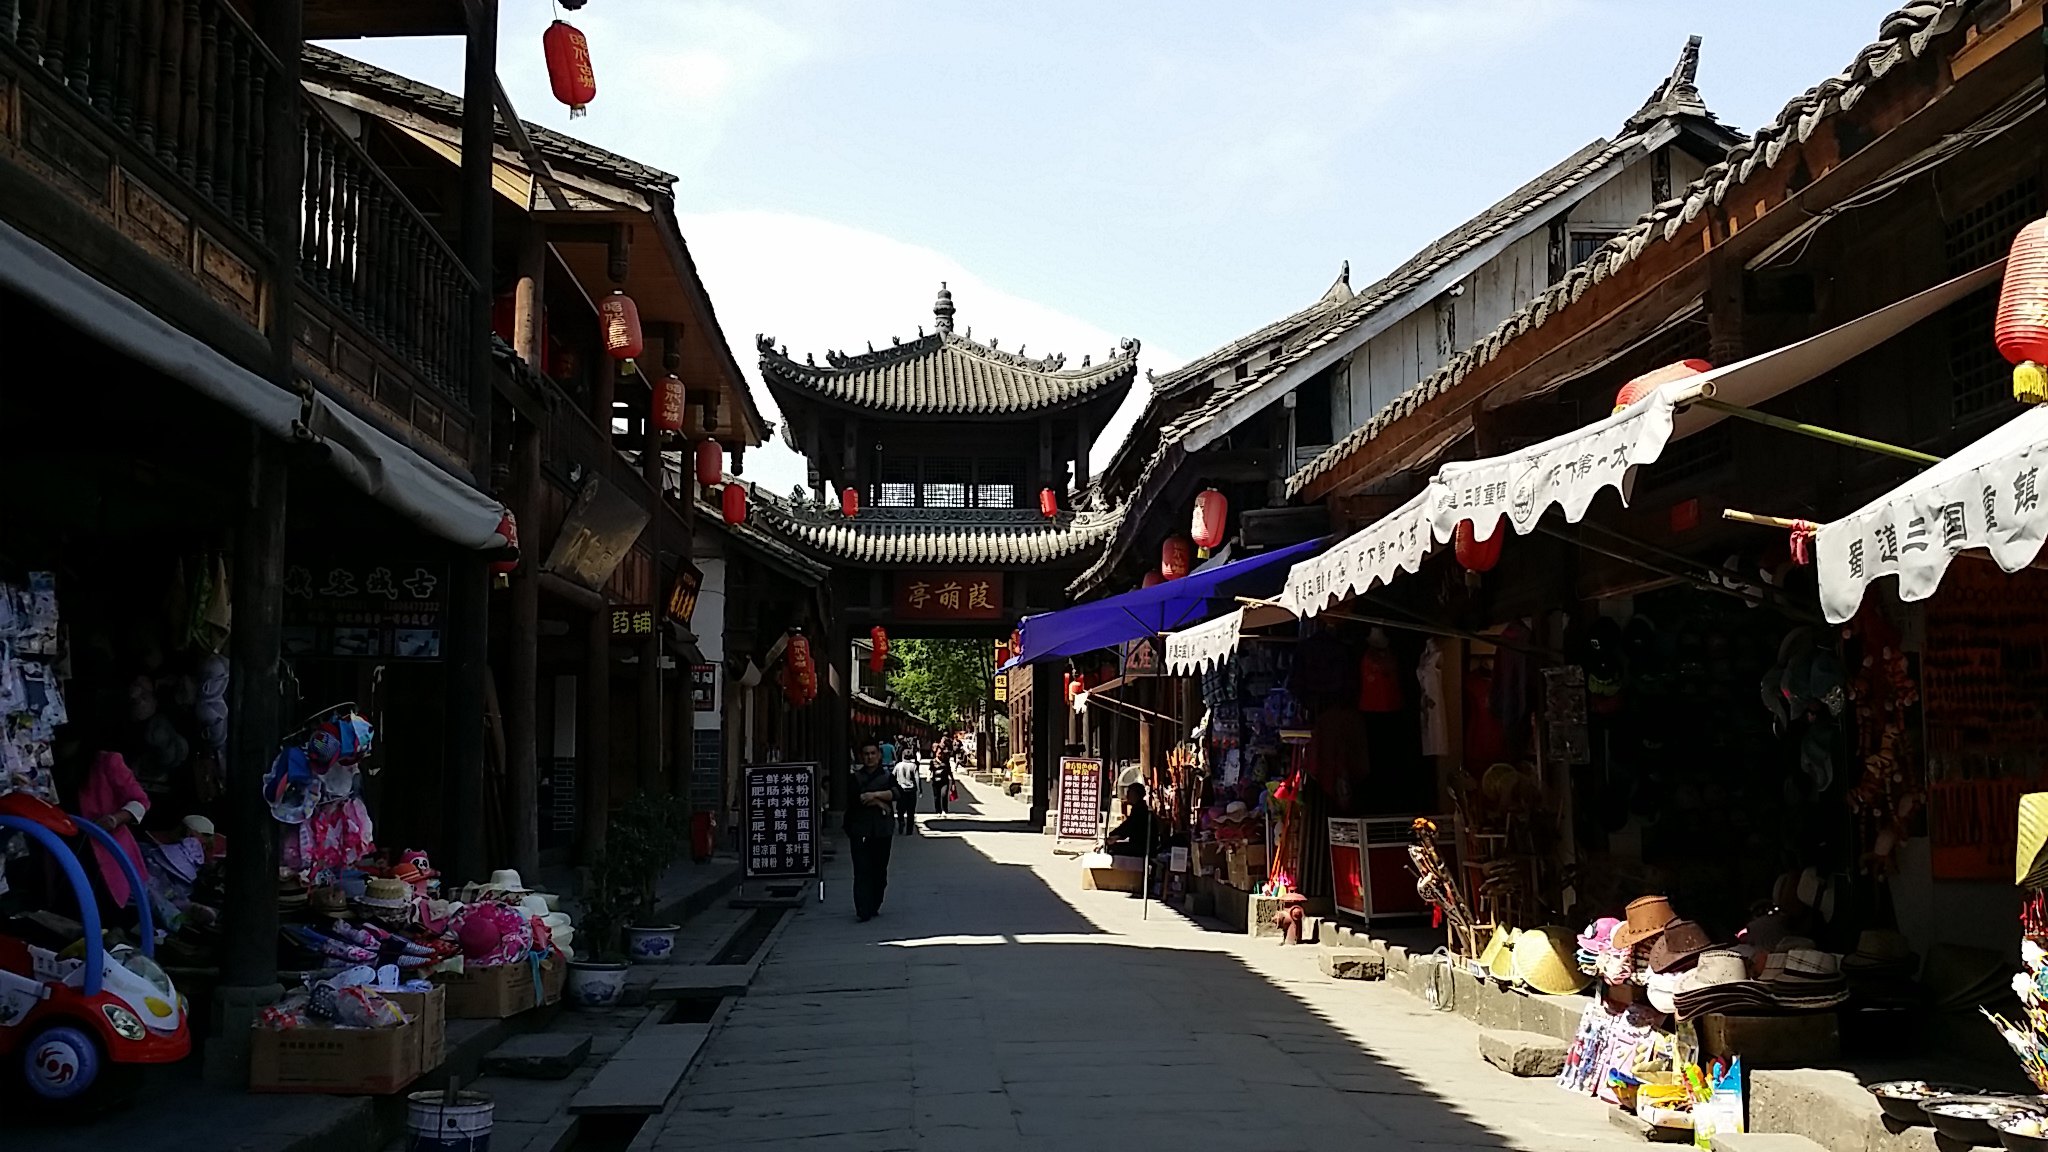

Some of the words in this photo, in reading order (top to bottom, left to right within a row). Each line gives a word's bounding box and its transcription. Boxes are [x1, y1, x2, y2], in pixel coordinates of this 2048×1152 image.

[1551, 443, 1631, 487] 天下第一太
[1849, 465, 2039, 579] 蜀道三国重镇
[612, 610, 652, 634] 药铺
[751, 773, 809, 785] 三鲜米粉
[751, 785, 810, 796] 肥肠米粉
[752, 796, 810, 808] 牛肉米粉
[752, 808, 810, 819] 三鲜面
[752, 820, 810, 831] 肥肠面
[752, 831, 811, 843] 牛肉面
